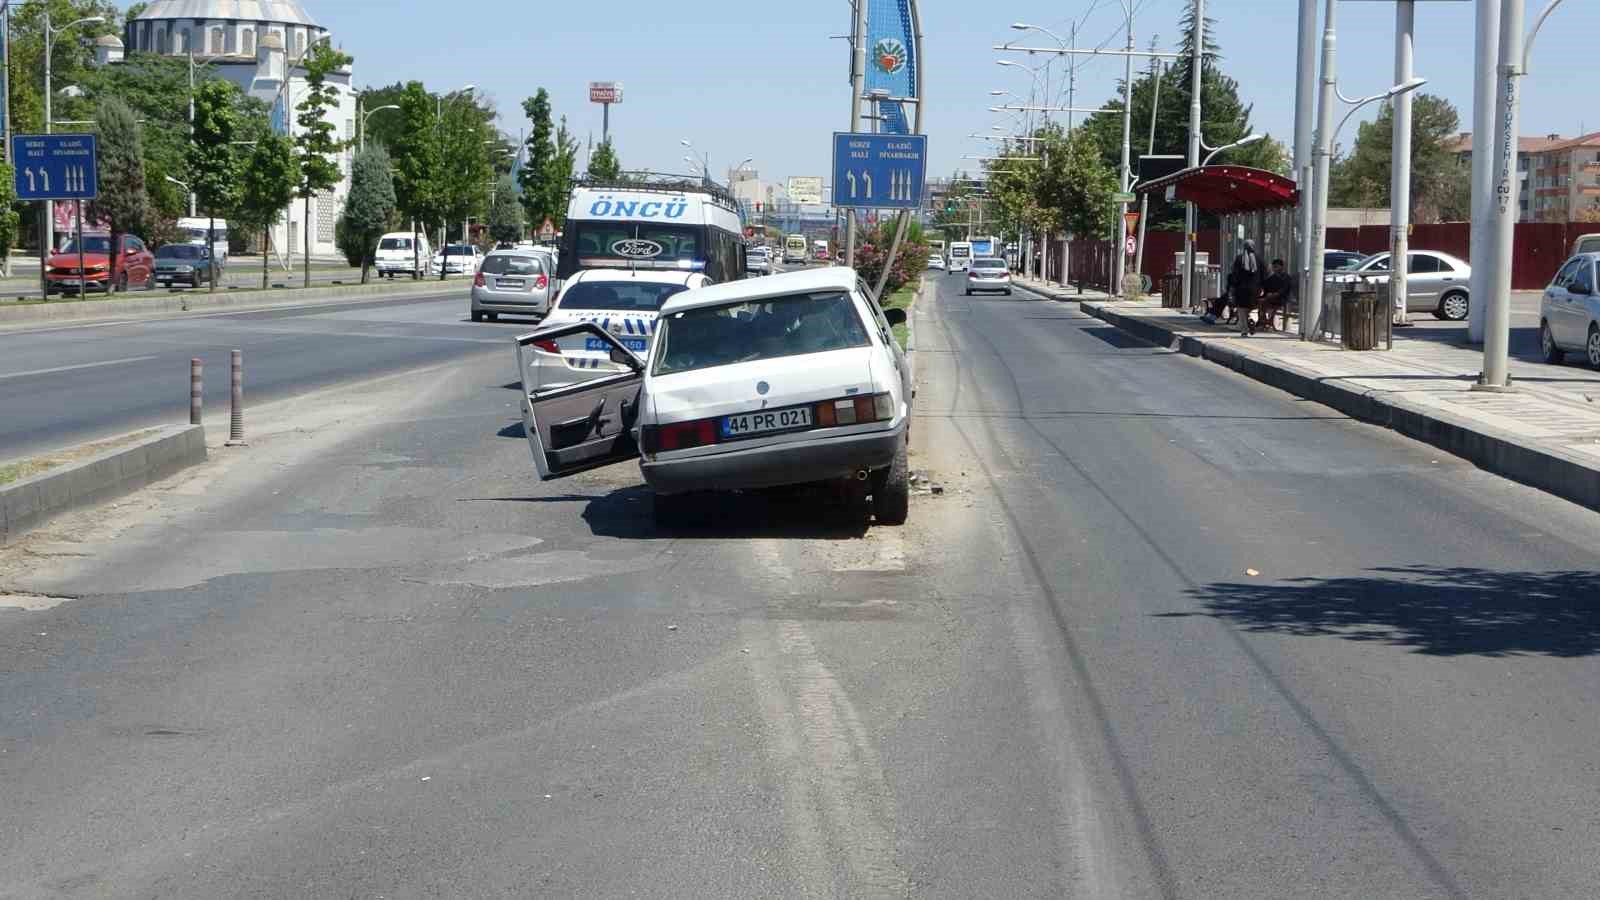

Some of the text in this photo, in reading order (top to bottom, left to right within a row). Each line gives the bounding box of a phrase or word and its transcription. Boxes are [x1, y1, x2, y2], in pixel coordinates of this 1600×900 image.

[589, 195, 688, 218] ÖNCÜ
[620, 240, 653, 255] Ford
[589, 339, 603, 349] 44
[730, 409, 807, 432] 44 PR 021
